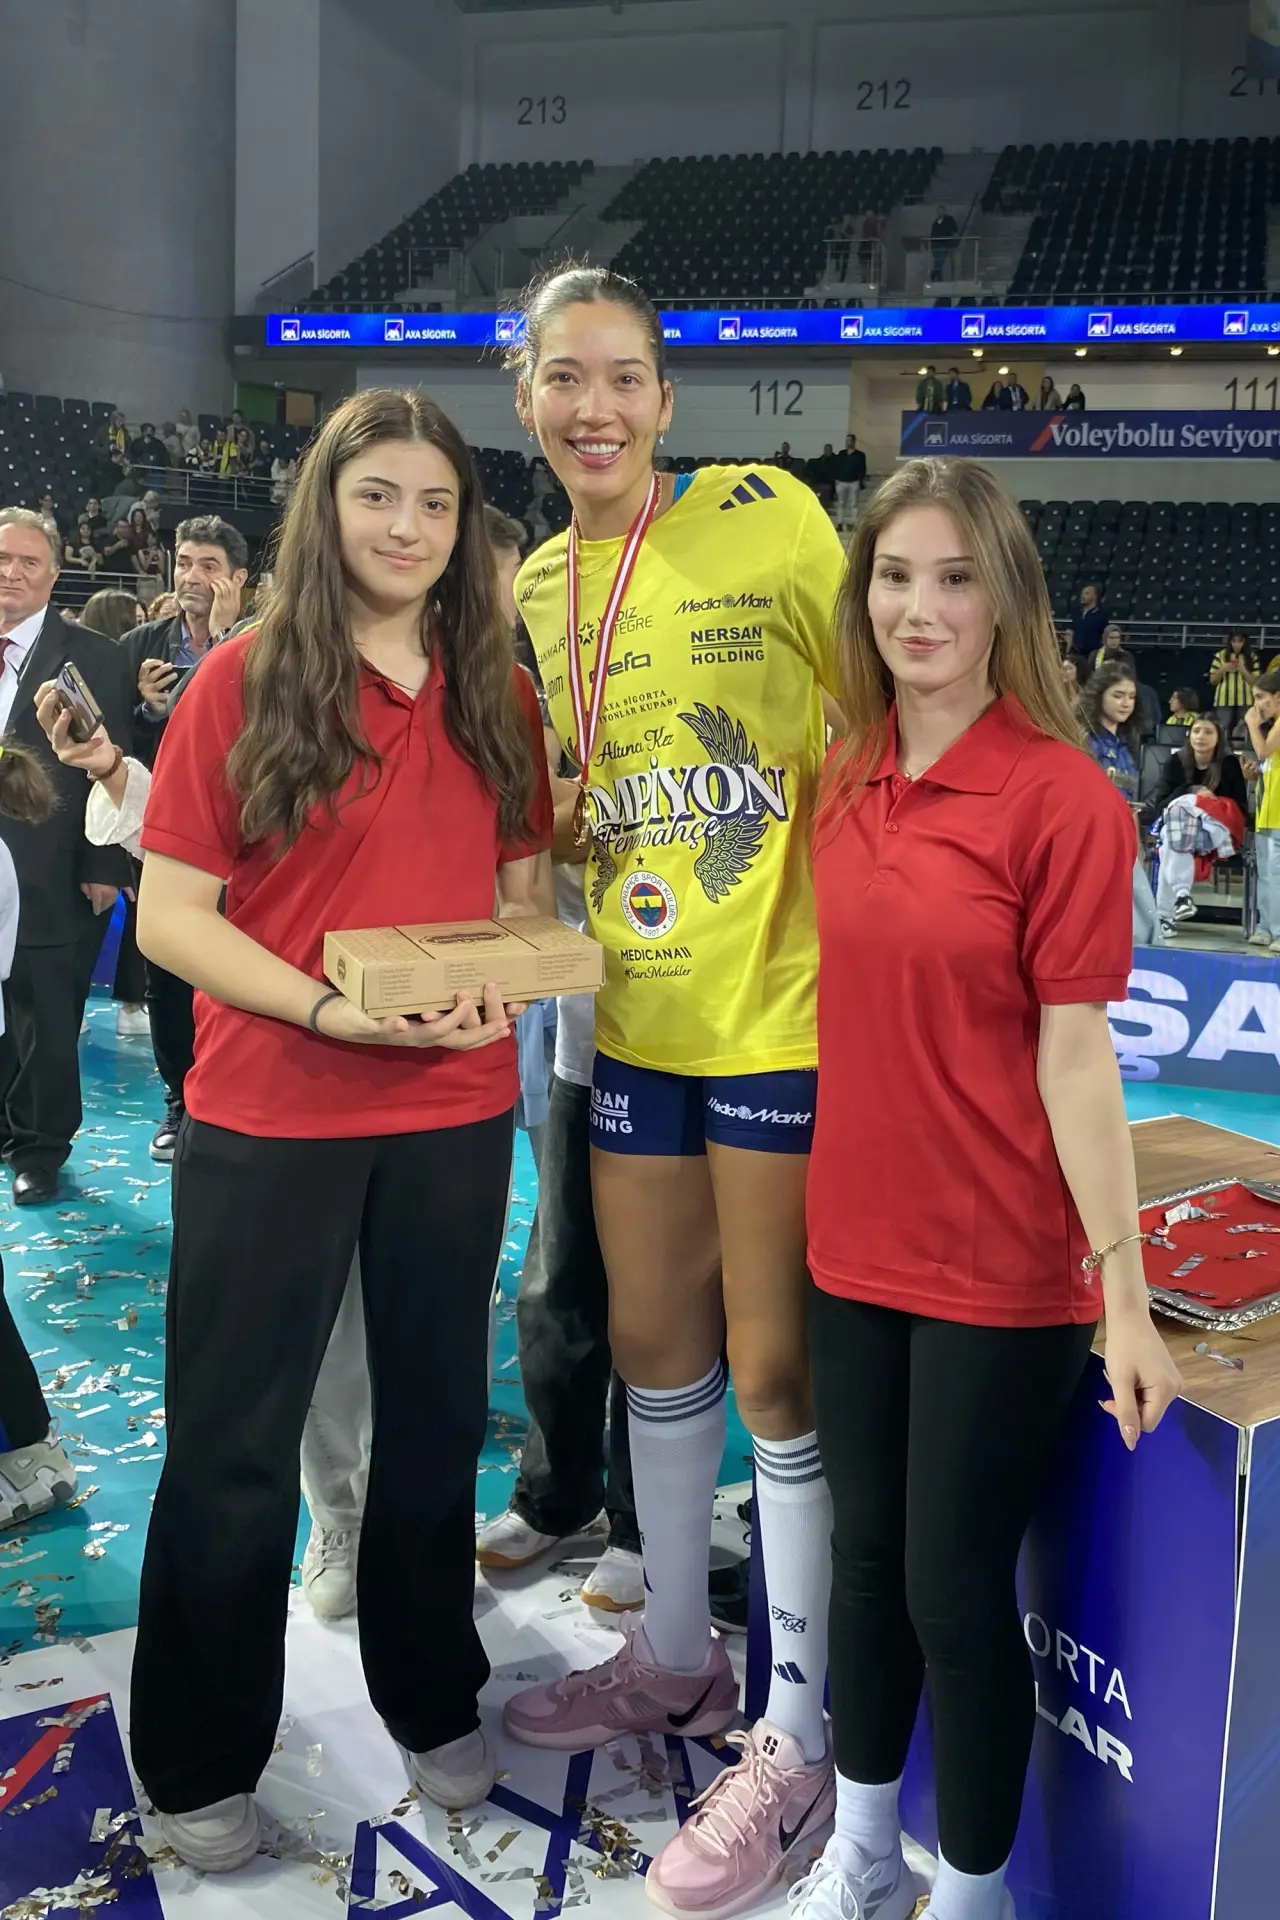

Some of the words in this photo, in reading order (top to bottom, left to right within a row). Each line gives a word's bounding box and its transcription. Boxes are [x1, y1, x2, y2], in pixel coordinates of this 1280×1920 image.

[856, 79, 911, 110] 212
[518, 95, 567, 125] 213
[301, 329, 317, 340] AXA
[317, 327, 351, 340] SİGORTA
[405, 329, 421, 340] AXA
[422, 327, 457, 340] SİGORTA
[741, 328, 759, 339] AXA
[760, 326, 798, 339] SİGORTA
[864, 327, 883, 337] AXA
[884, 325, 923, 338] SİGORTA
[985, 325, 1004, 336] AXA
[1005, 323, 1047, 336] SİGORTA
[1112, 323, 1133, 335] AXA
[1133, 321, 1177, 335] SİGORTA
[1249, 322, 1270, 333] AXA
[749, 379, 804, 416] 112
[1225, 377, 1279, 411] 111
[949, 434, 970, 445] AXA
[970, 432, 1013, 445] SİGORTA
[1049, 422, 1175, 452] Voleybolu
[690, 626, 762, 643] NERSAN
[691, 647, 765, 665] HOLDİNG
[603, 701, 620, 713] AXA
[640, 697, 677, 712] KUPASI
[641, 873, 664, 888] SPOR
[644, 928, 660, 937] 1907
